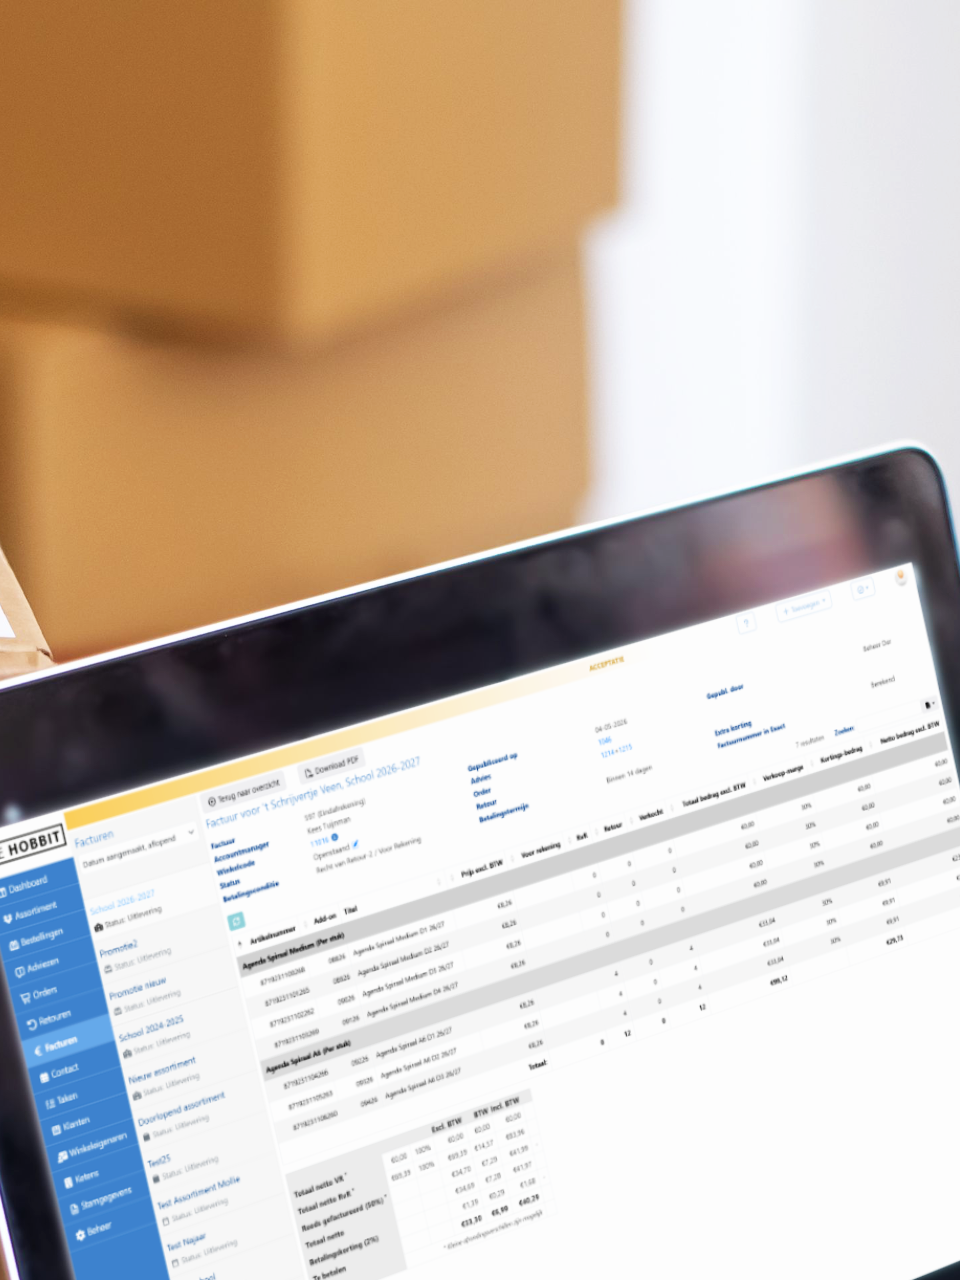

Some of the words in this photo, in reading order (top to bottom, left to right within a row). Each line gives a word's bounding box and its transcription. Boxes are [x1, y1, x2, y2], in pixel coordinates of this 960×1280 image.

[714, 727, 731, 737] Extra
[729, 720, 753, 732] korting
[314, 759, 347, 776] Download
[346, 754, 359, 765] PDF
[508, 752, 519, 761] op
[470, 773, 492, 786] Advies
[205, 812, 239, 830] Factuur
[239, 805, 261, 819] voor
[269, 788, 319, 811] Schrijvertje
[319, 781, 345, 795] Veen,
[344, 769, 375, 788] School
[375, 755, 421, 779] 2026-2027
[217, 792, 237, 803] Terug
[236, 788, 251, 798] naar
[251, 778, 281, 794] overzicht
[472, 787, 492, 798] Order
[475, 799, 498, 811] Retour
[306, 825, 323, 835] Kees
[7, 830, 60, 857] HOBBIT
[73, 830, 115, 849] Facturen
[210, 837, 236, 850] Factuur
[312, 843, 351, 862] Openstaand
[334, 860, 347, 869] van
[377, 845, 393, 855] Voor
[82, 857, 106, 869] Datum
[216, 859, 256, 877] Winkelcode
[8, 874, 49, 895] Dashboard
[219, 878, 241, 890] Status
[14, 900, 58, 921] Assortiment
[89, 901, 116, 917] School
[116, 888, 155, 908] 2026-2027
[343, 905, 358, 916] Titel
[104, 917, 126, 929] Status:
[126, 906, 163, 922] Uitlevering
[20, 928, 64, 947] Bestellingen
[98, 938, 138, 959] Promotie2
[26, 957, 60, 973] Adviezen
[113, 959, 136, 972] Status:
[136, 947, 173, 964] Uitlevering
[32, 986, 58, 1000] Orders
[108, 984, 144, 1001] Promotie
[144, 977, 167, 989] nieuw
[38, 1010, 72, 1026] Retouren
[118, 1027, 145, 1043] School
[145, 1013, 185, 1035] 2024-2025
[44, 1036, 79, 1053] Facturen
[50, 1062, 80, 1079] Contact
[127, 1071, 153, 1085] Nieuw
[153, 1056, 197, 1077] assortiment
[56, 1092, 79, 1105] Taken
[137, 1105, 183, 1128] Doorlopend
[182, 1091, 226, 1112] assortiment
[62, 1116, 91, 1131] Klanten
[147, 1153, 172, 1169] Test25
[74, 1170, 100, 1184] Ketens
[80, 1186, 133, 1211] Stamgegevens
[156, 1199, 173, 1210] Test
[173, 1183, 217, 1205] Assortiment
[86, 1221, 112, 1237] Beheer
[166, 1240, 182, 1252] Test
[182, 1233, 207, 1247] Najaar
[304, 1235, 326, 1249] Totaal
[326, 1230, 345, 1241] netto
[321, 1266, 347, 1280] betalen
